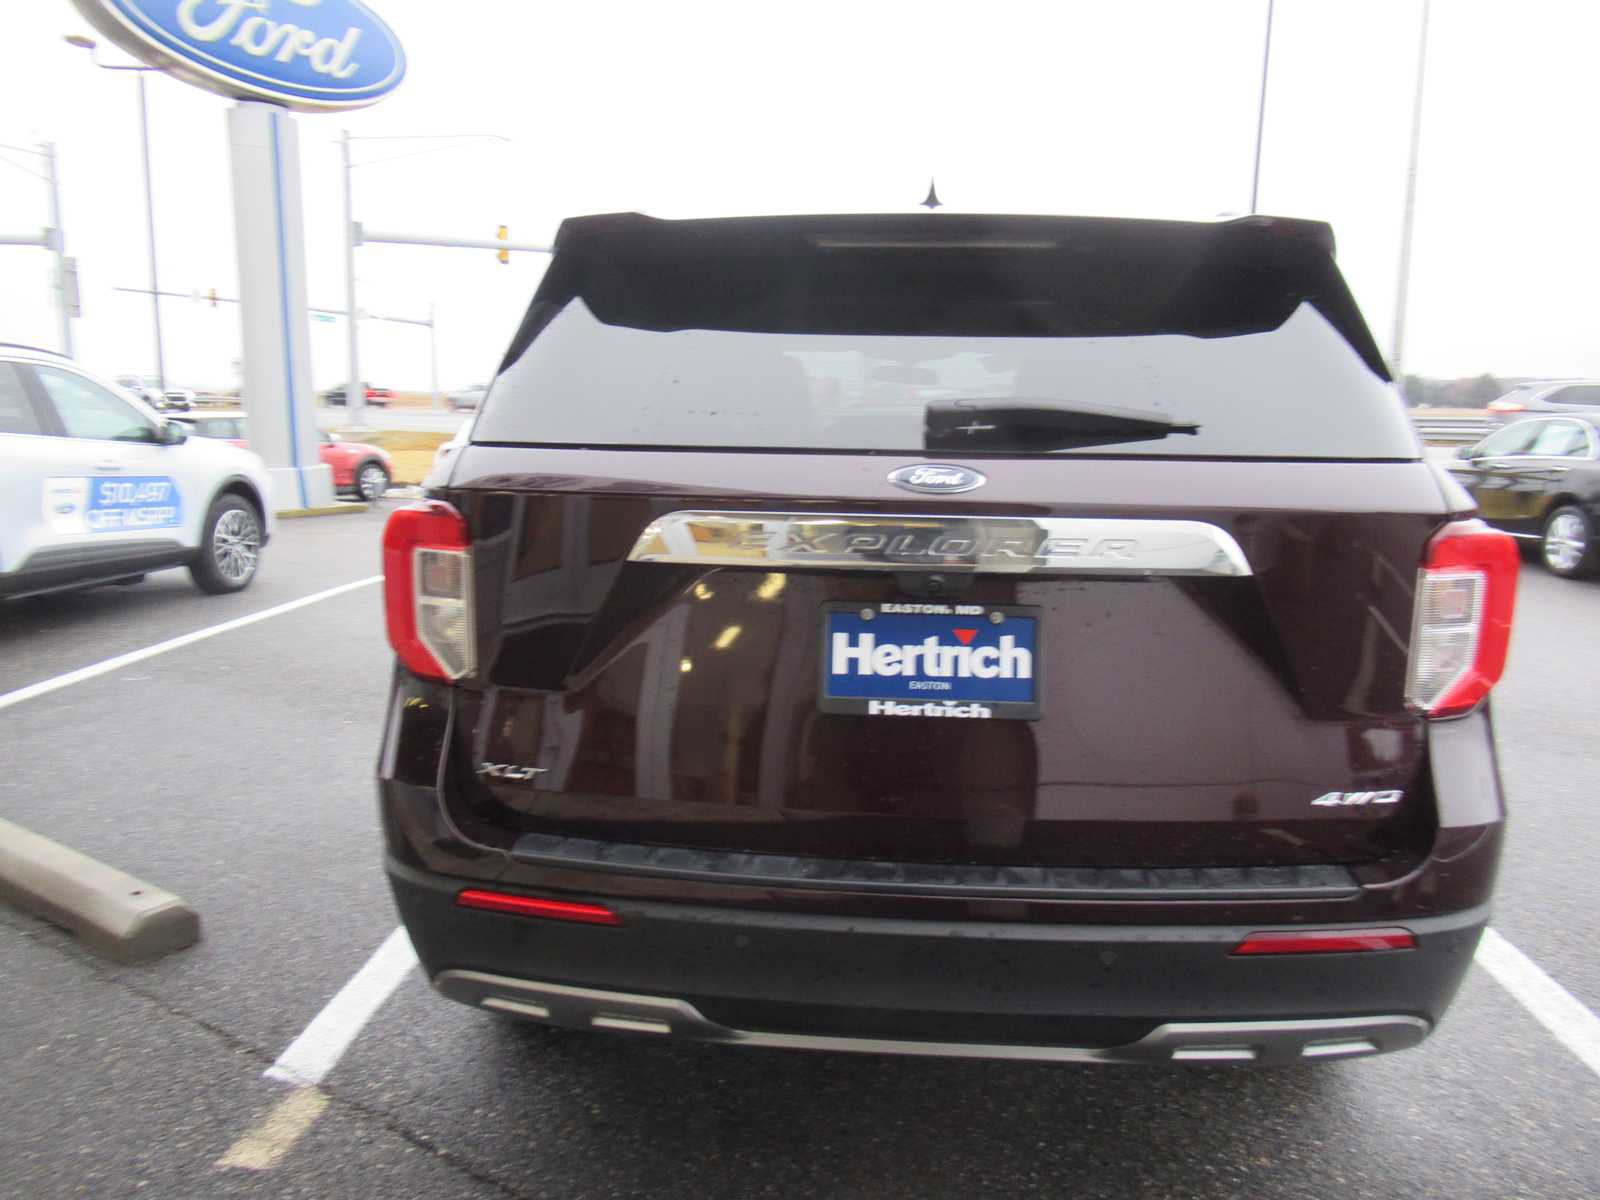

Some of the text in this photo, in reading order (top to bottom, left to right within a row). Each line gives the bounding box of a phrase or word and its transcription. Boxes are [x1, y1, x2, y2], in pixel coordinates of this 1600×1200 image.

[176, 0, 362, 79] Ford
[909, 467, 964, 485] Ford
[735, 532, 1141, 561] EXPLORER
[955, 605, 984, 615] MD
[831, 632, 1033, 679] Hertrich
[908, 680, 952, 690] EASTON
[867, 699, 993, 719] Hertrich
[475, 762, 549, 780] XLT
[1310, 790, 1405, 807] 4WD
